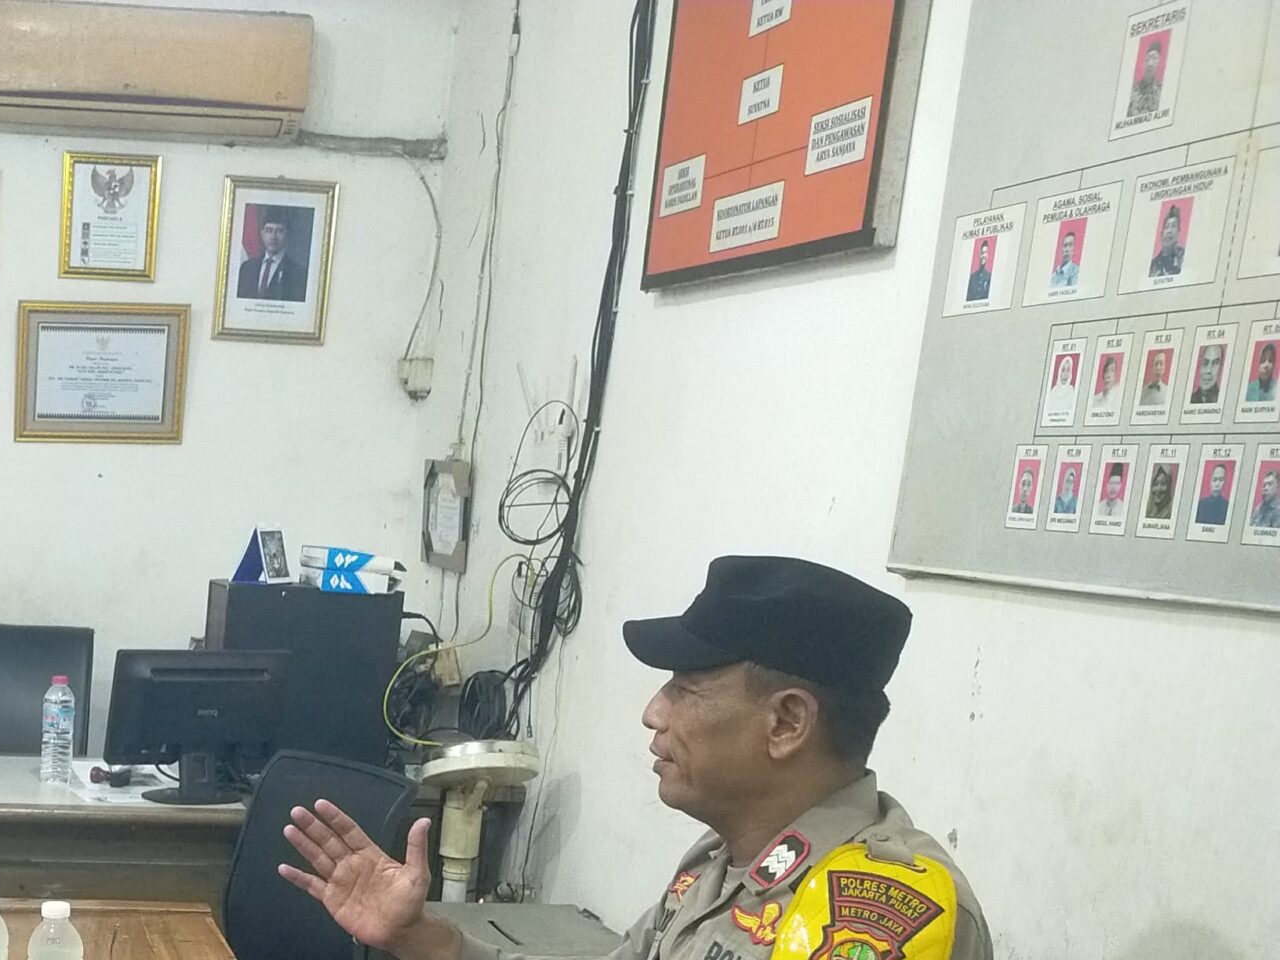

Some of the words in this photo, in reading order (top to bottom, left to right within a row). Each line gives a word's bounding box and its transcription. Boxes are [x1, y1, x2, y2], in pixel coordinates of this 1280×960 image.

[1130, 7, 1186, 37] SEKRETARIS
[830, 106, 866, 129] SOSIALISASI
[1115, 112, 1152, 130] MUHAMMAD
[824, 122, 865, 146] PENGAWASAN
[1171, 168, 1221, 185] PEMBANGUNAN
[1150, 186, 1191, 201] LINGKUNGAN
[1193, 180, 1214, 192] HIDUP
[1043, 210, 1068, 223] PEMUDA
[1075, 202, 1111, 217] OLAHRAGA
[986, 222, 1014, 235] PUBLIKASI
[840, 878, 887, 894] POLRES
[888, 887, 928, 913] METRO
[841, 887, 886, 903] JAKARTA
[888, 898, 919, 919] PUSAT
[841, 907, 878, 921] METRO
[880, 917, 904, 935] JAYA
